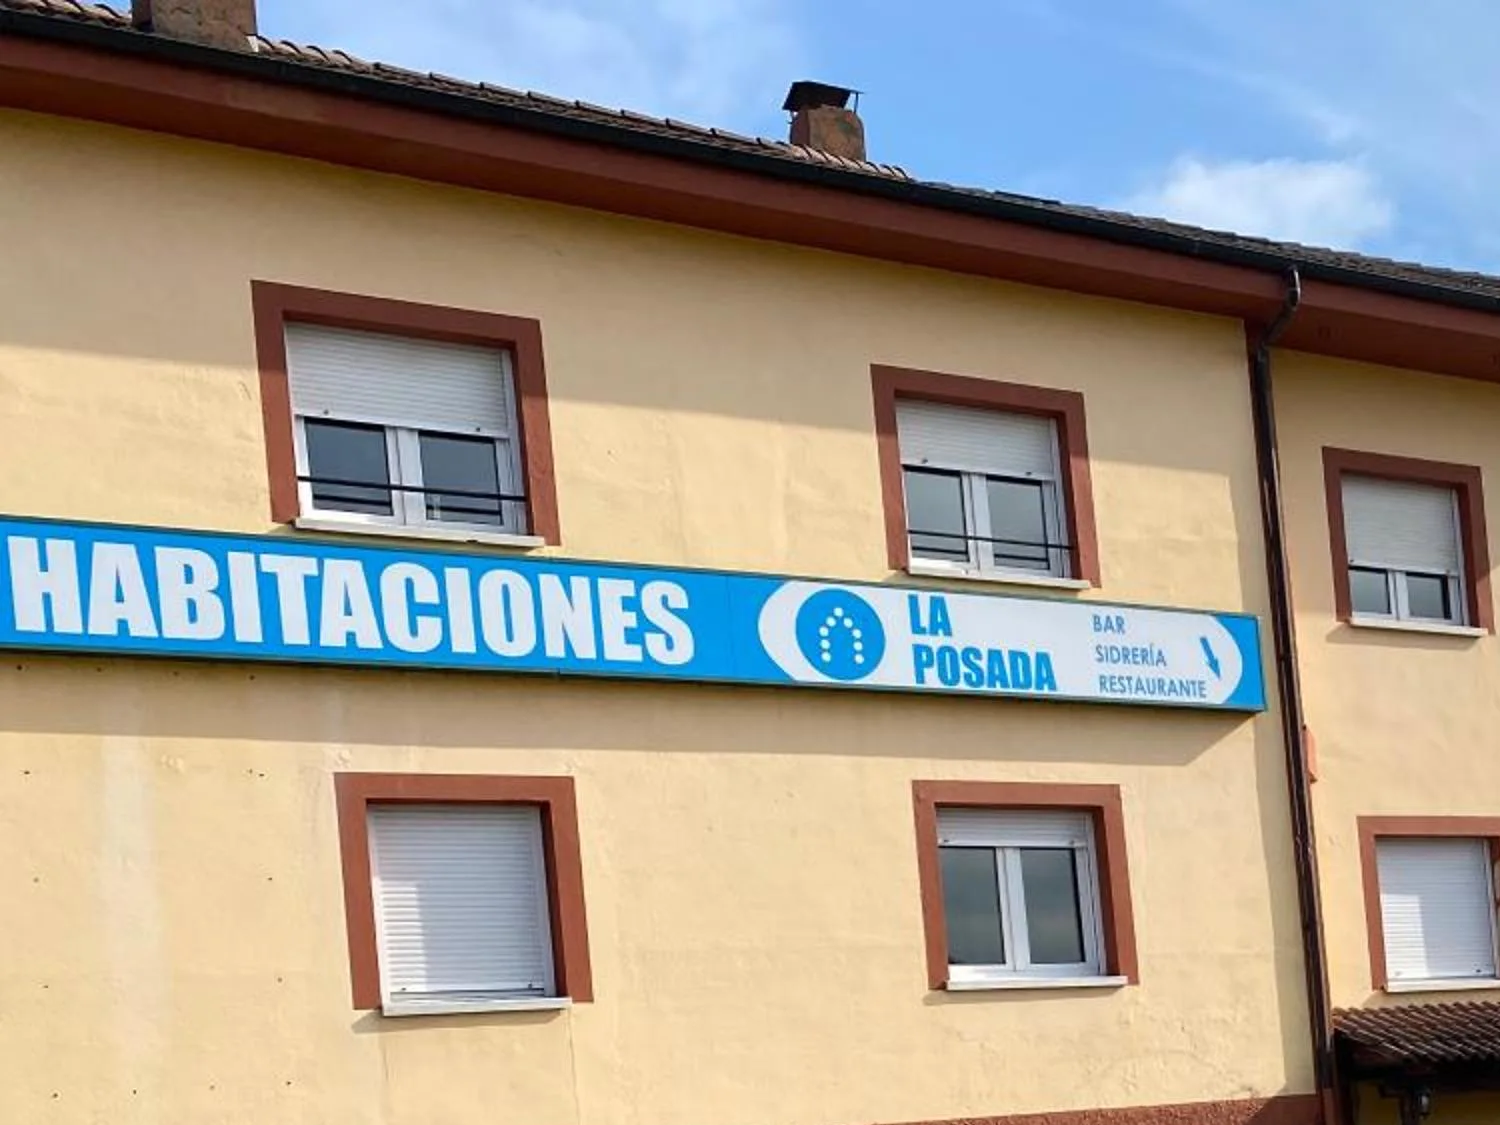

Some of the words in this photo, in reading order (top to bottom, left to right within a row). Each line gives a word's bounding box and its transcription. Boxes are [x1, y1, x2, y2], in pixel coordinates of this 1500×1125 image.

[7, 535, 696, 666] HABITACIONES
[907, 593, 953, 636] LA
[1093, 614, 1126, 634] BAR
[911, 643, 1057, 691] POSADA
[1095, 643, 1167, 667] SIDRERÍA
[1099, 675, 1207, 699] RESTAURANTE
